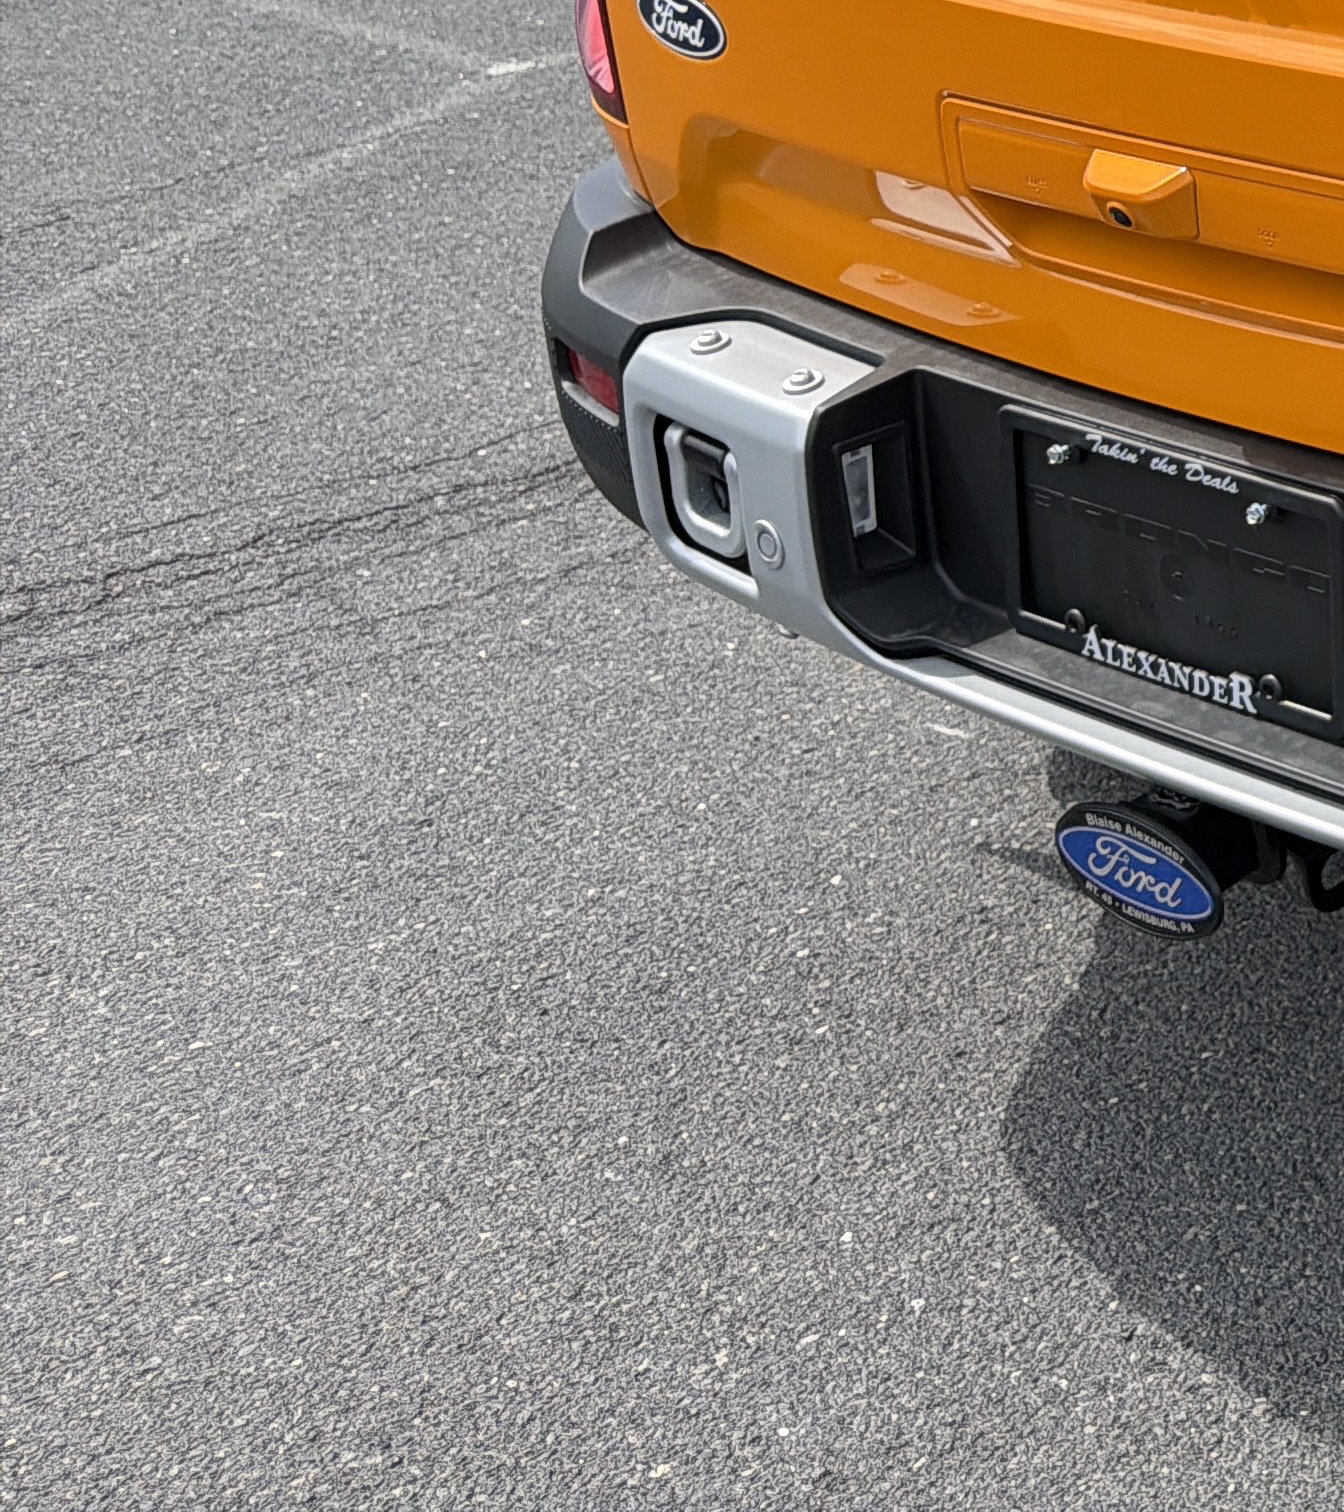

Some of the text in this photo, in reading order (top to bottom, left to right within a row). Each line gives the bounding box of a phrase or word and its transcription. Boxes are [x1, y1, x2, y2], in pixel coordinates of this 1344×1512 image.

[1085, 434, 1240, 495] Takin' the Deals
[1081, 625, 1258, 715] ALEXANDER
[1085, 812, 1186, 865] Blaise Alexander
[1087, 836, 1182, 908] Ford
[1121, 902, 1181, 932] LEWISBURG,
[1181, 921, 1196, 933] PA
